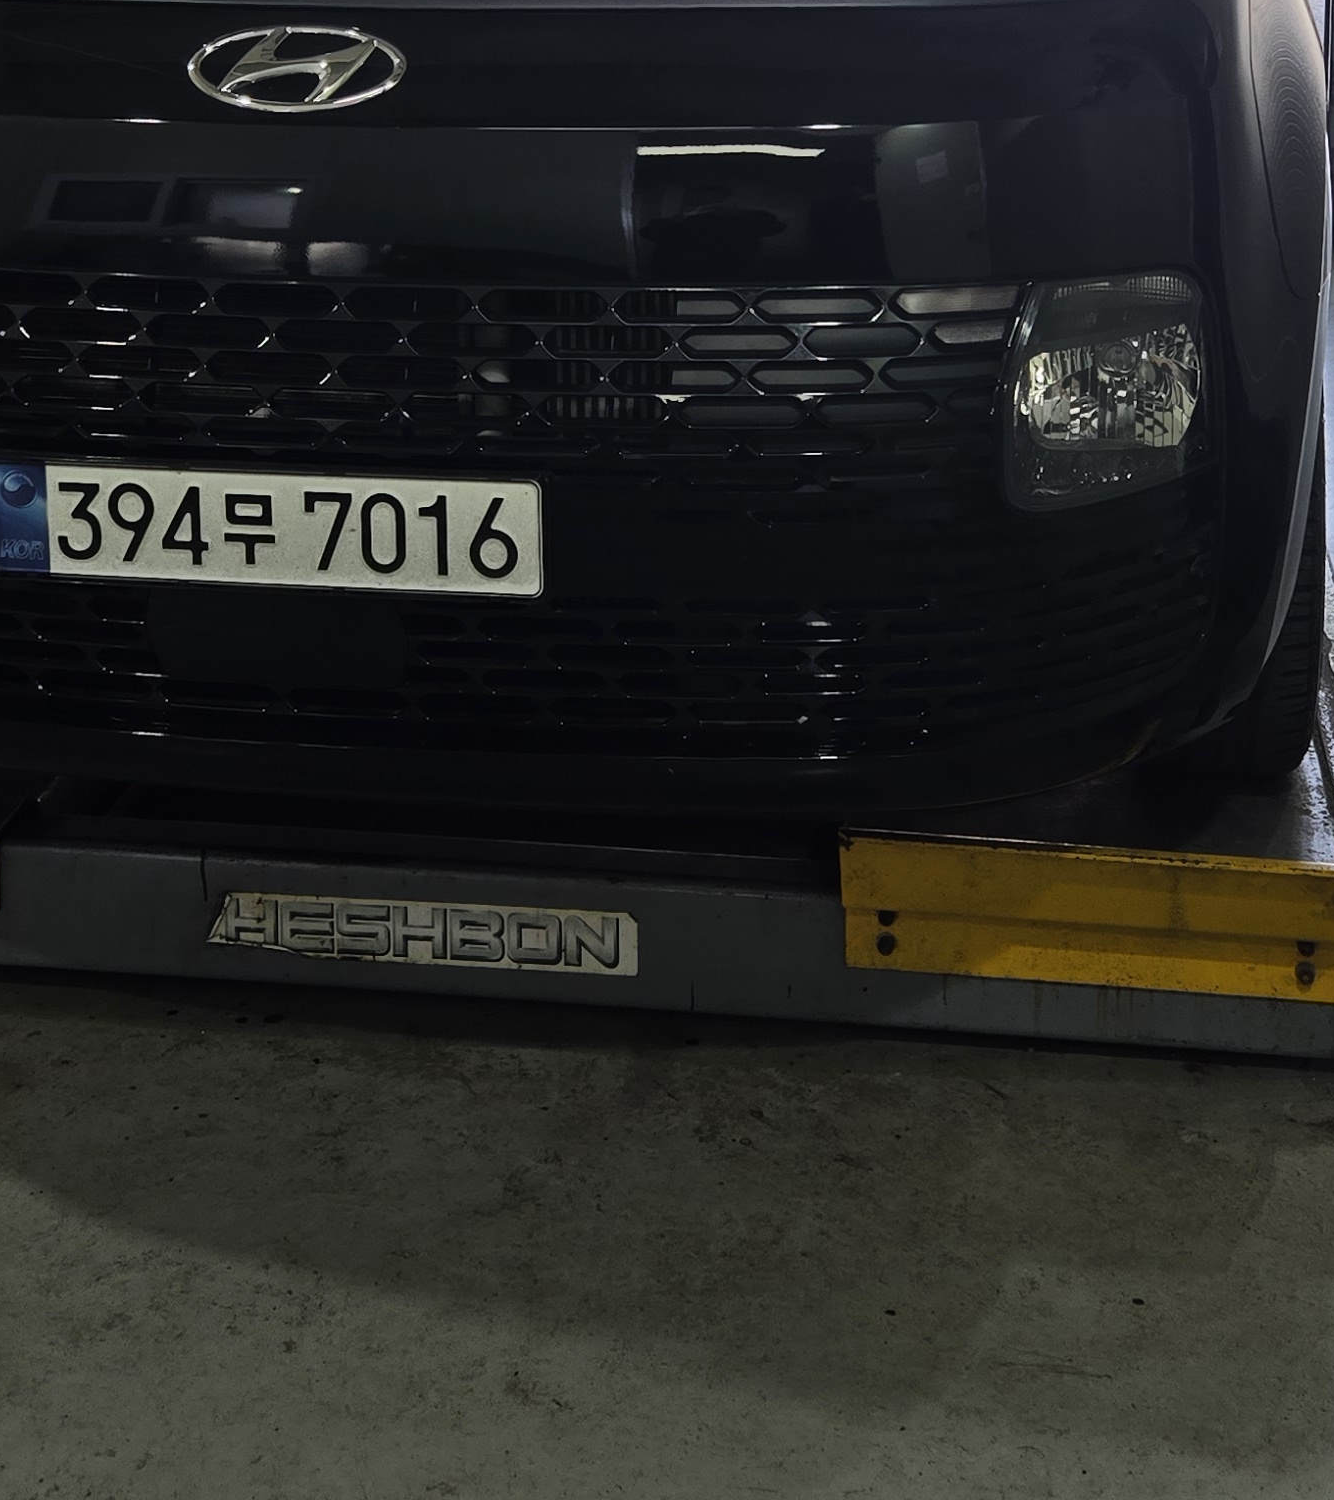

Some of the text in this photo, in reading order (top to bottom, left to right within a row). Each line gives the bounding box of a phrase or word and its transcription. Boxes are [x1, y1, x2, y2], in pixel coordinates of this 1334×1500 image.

[0, 538, 45, 560] KOR
[57, 481, 520, 579] 394무 7016
[224, 897, 622, 970] HESHBON
